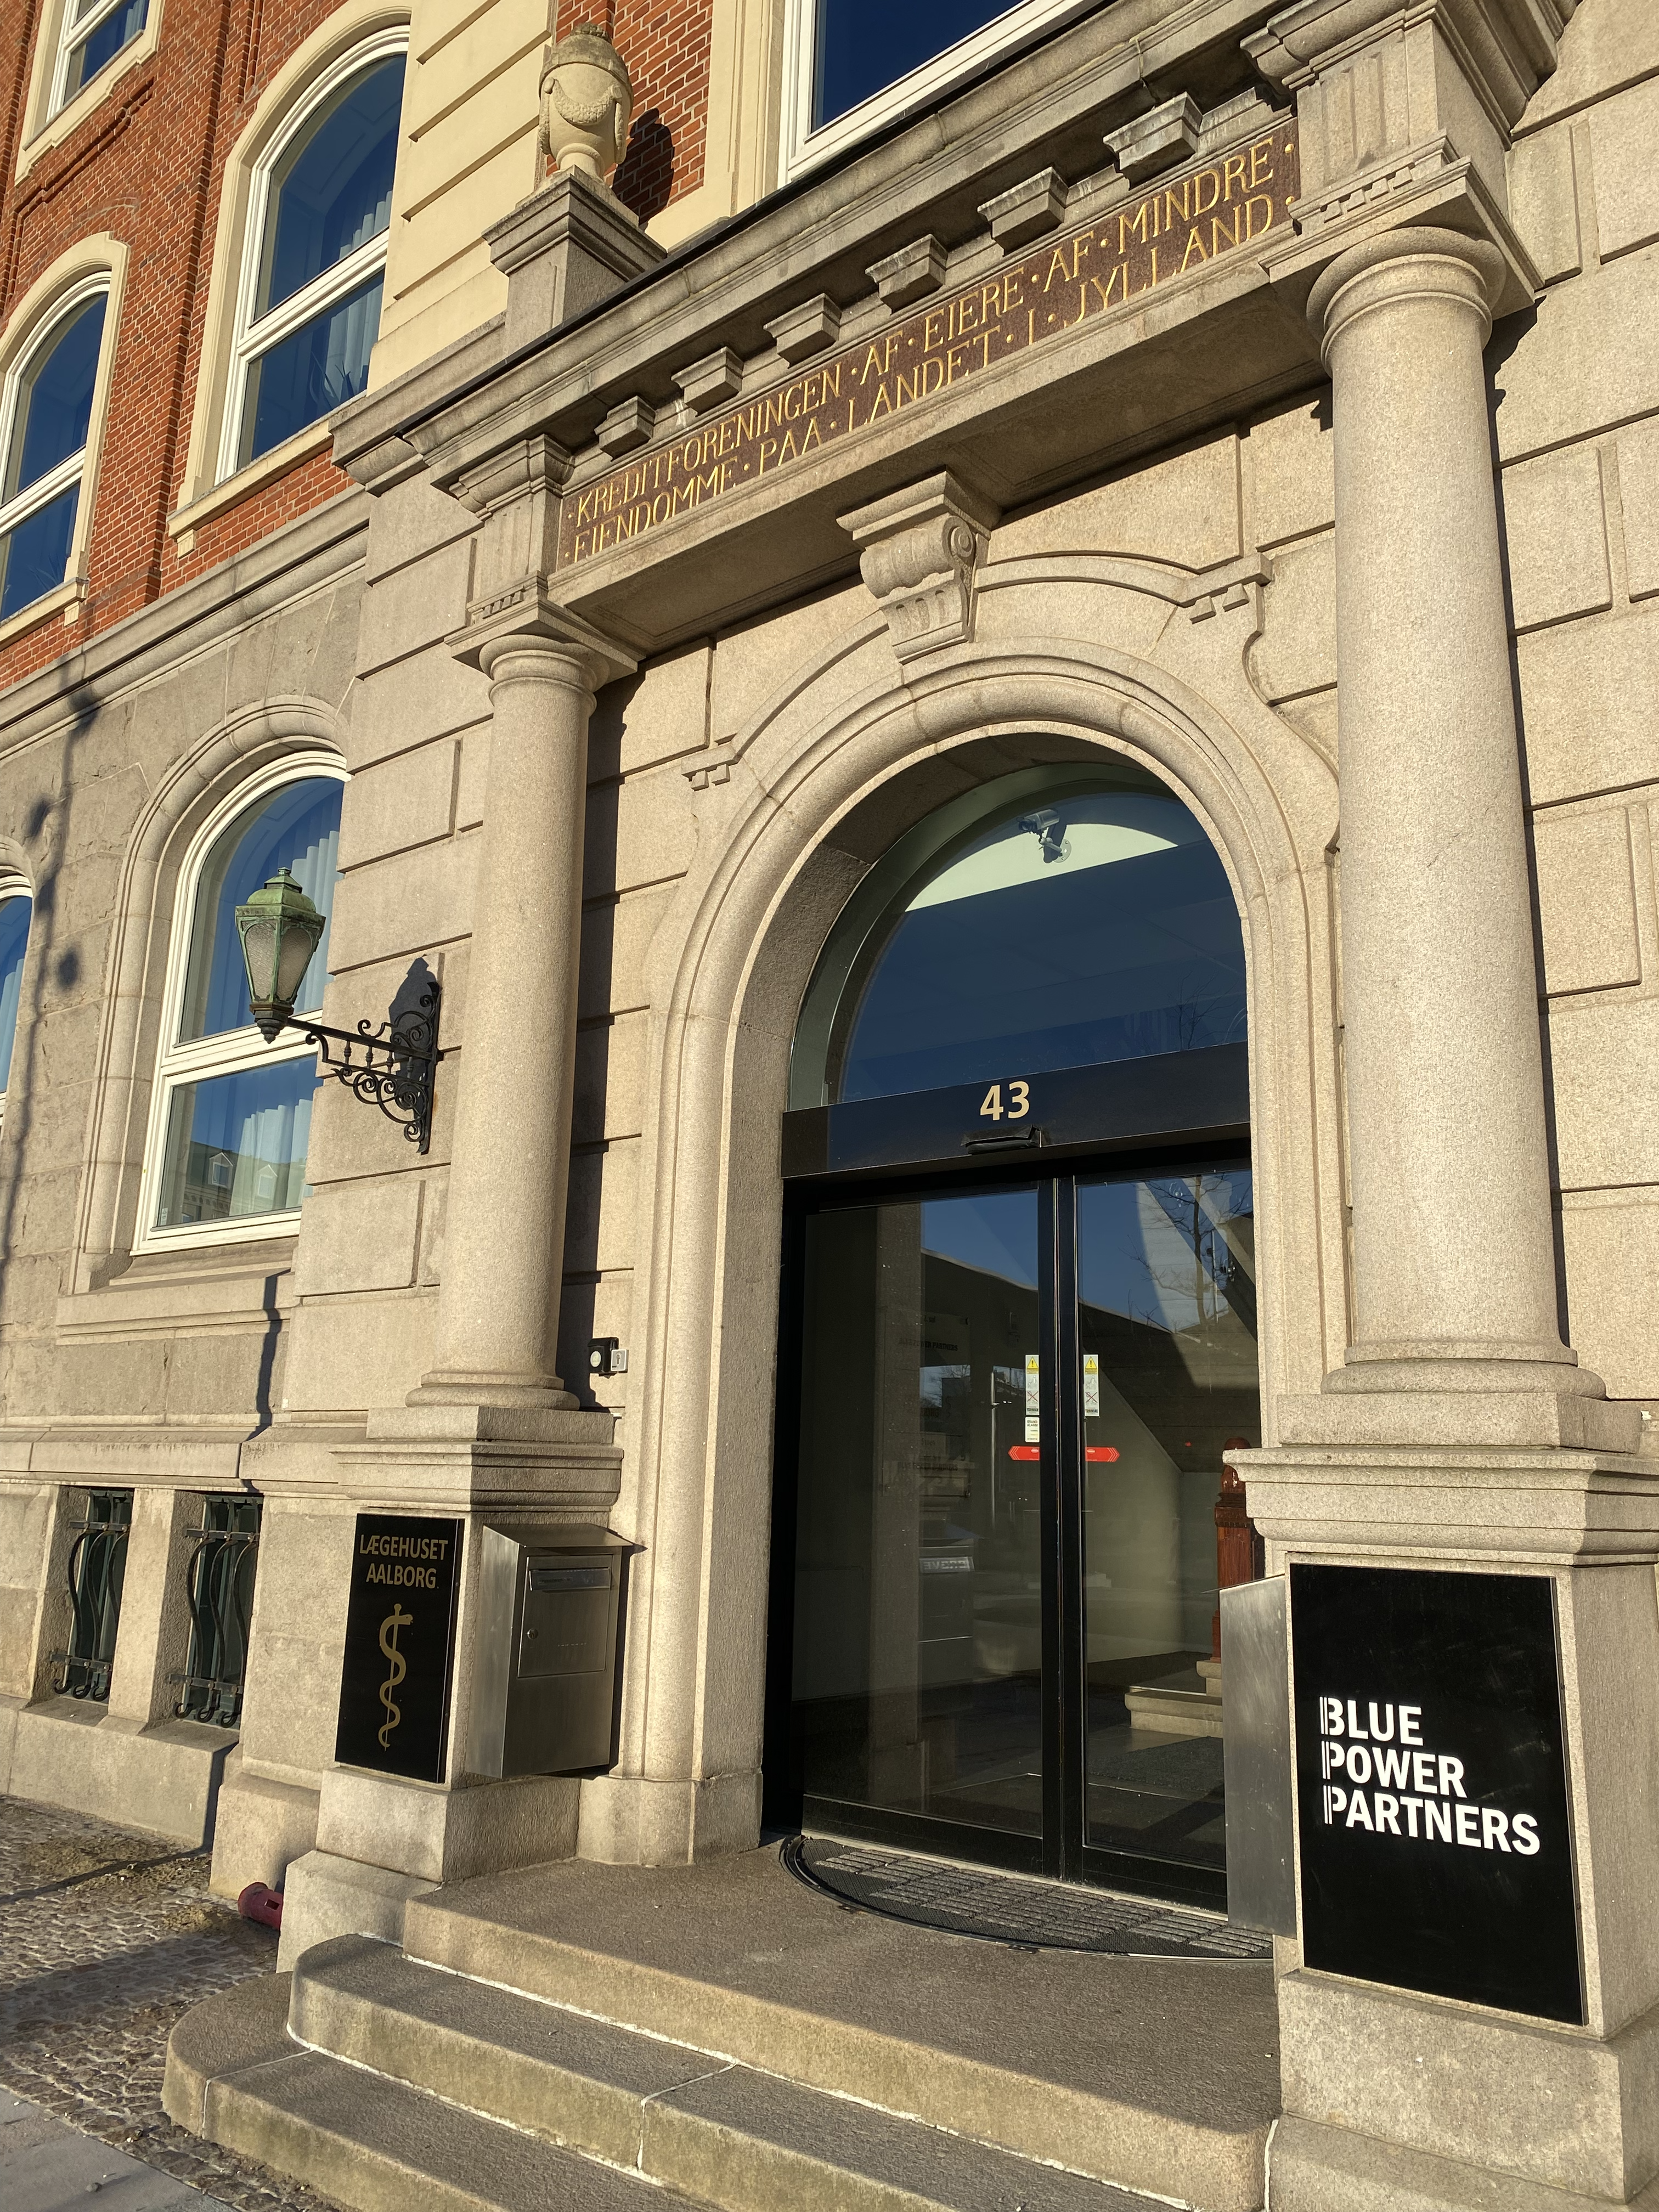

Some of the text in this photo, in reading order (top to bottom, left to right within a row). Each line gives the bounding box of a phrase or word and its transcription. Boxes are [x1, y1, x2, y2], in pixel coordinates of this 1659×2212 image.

[576, 137, 1273, 527] KREDITFORENINGEN AF EIERE AF MINDRE
[759, 416, 822, 476] PAA
[849, 326, 1000, 432] LANDET
[980, 1081, 1030, 1121] 43
[359, 1534, 448, 1560] LÆGEHUSET
[366, 1563, 437, 1589] AALBORG
[1319, 1696, 1424, 1746] BLUE
[1321, 1741, 1468, 1798] POWER
[1323, 1785, 1541, 1855] PARTNERS
